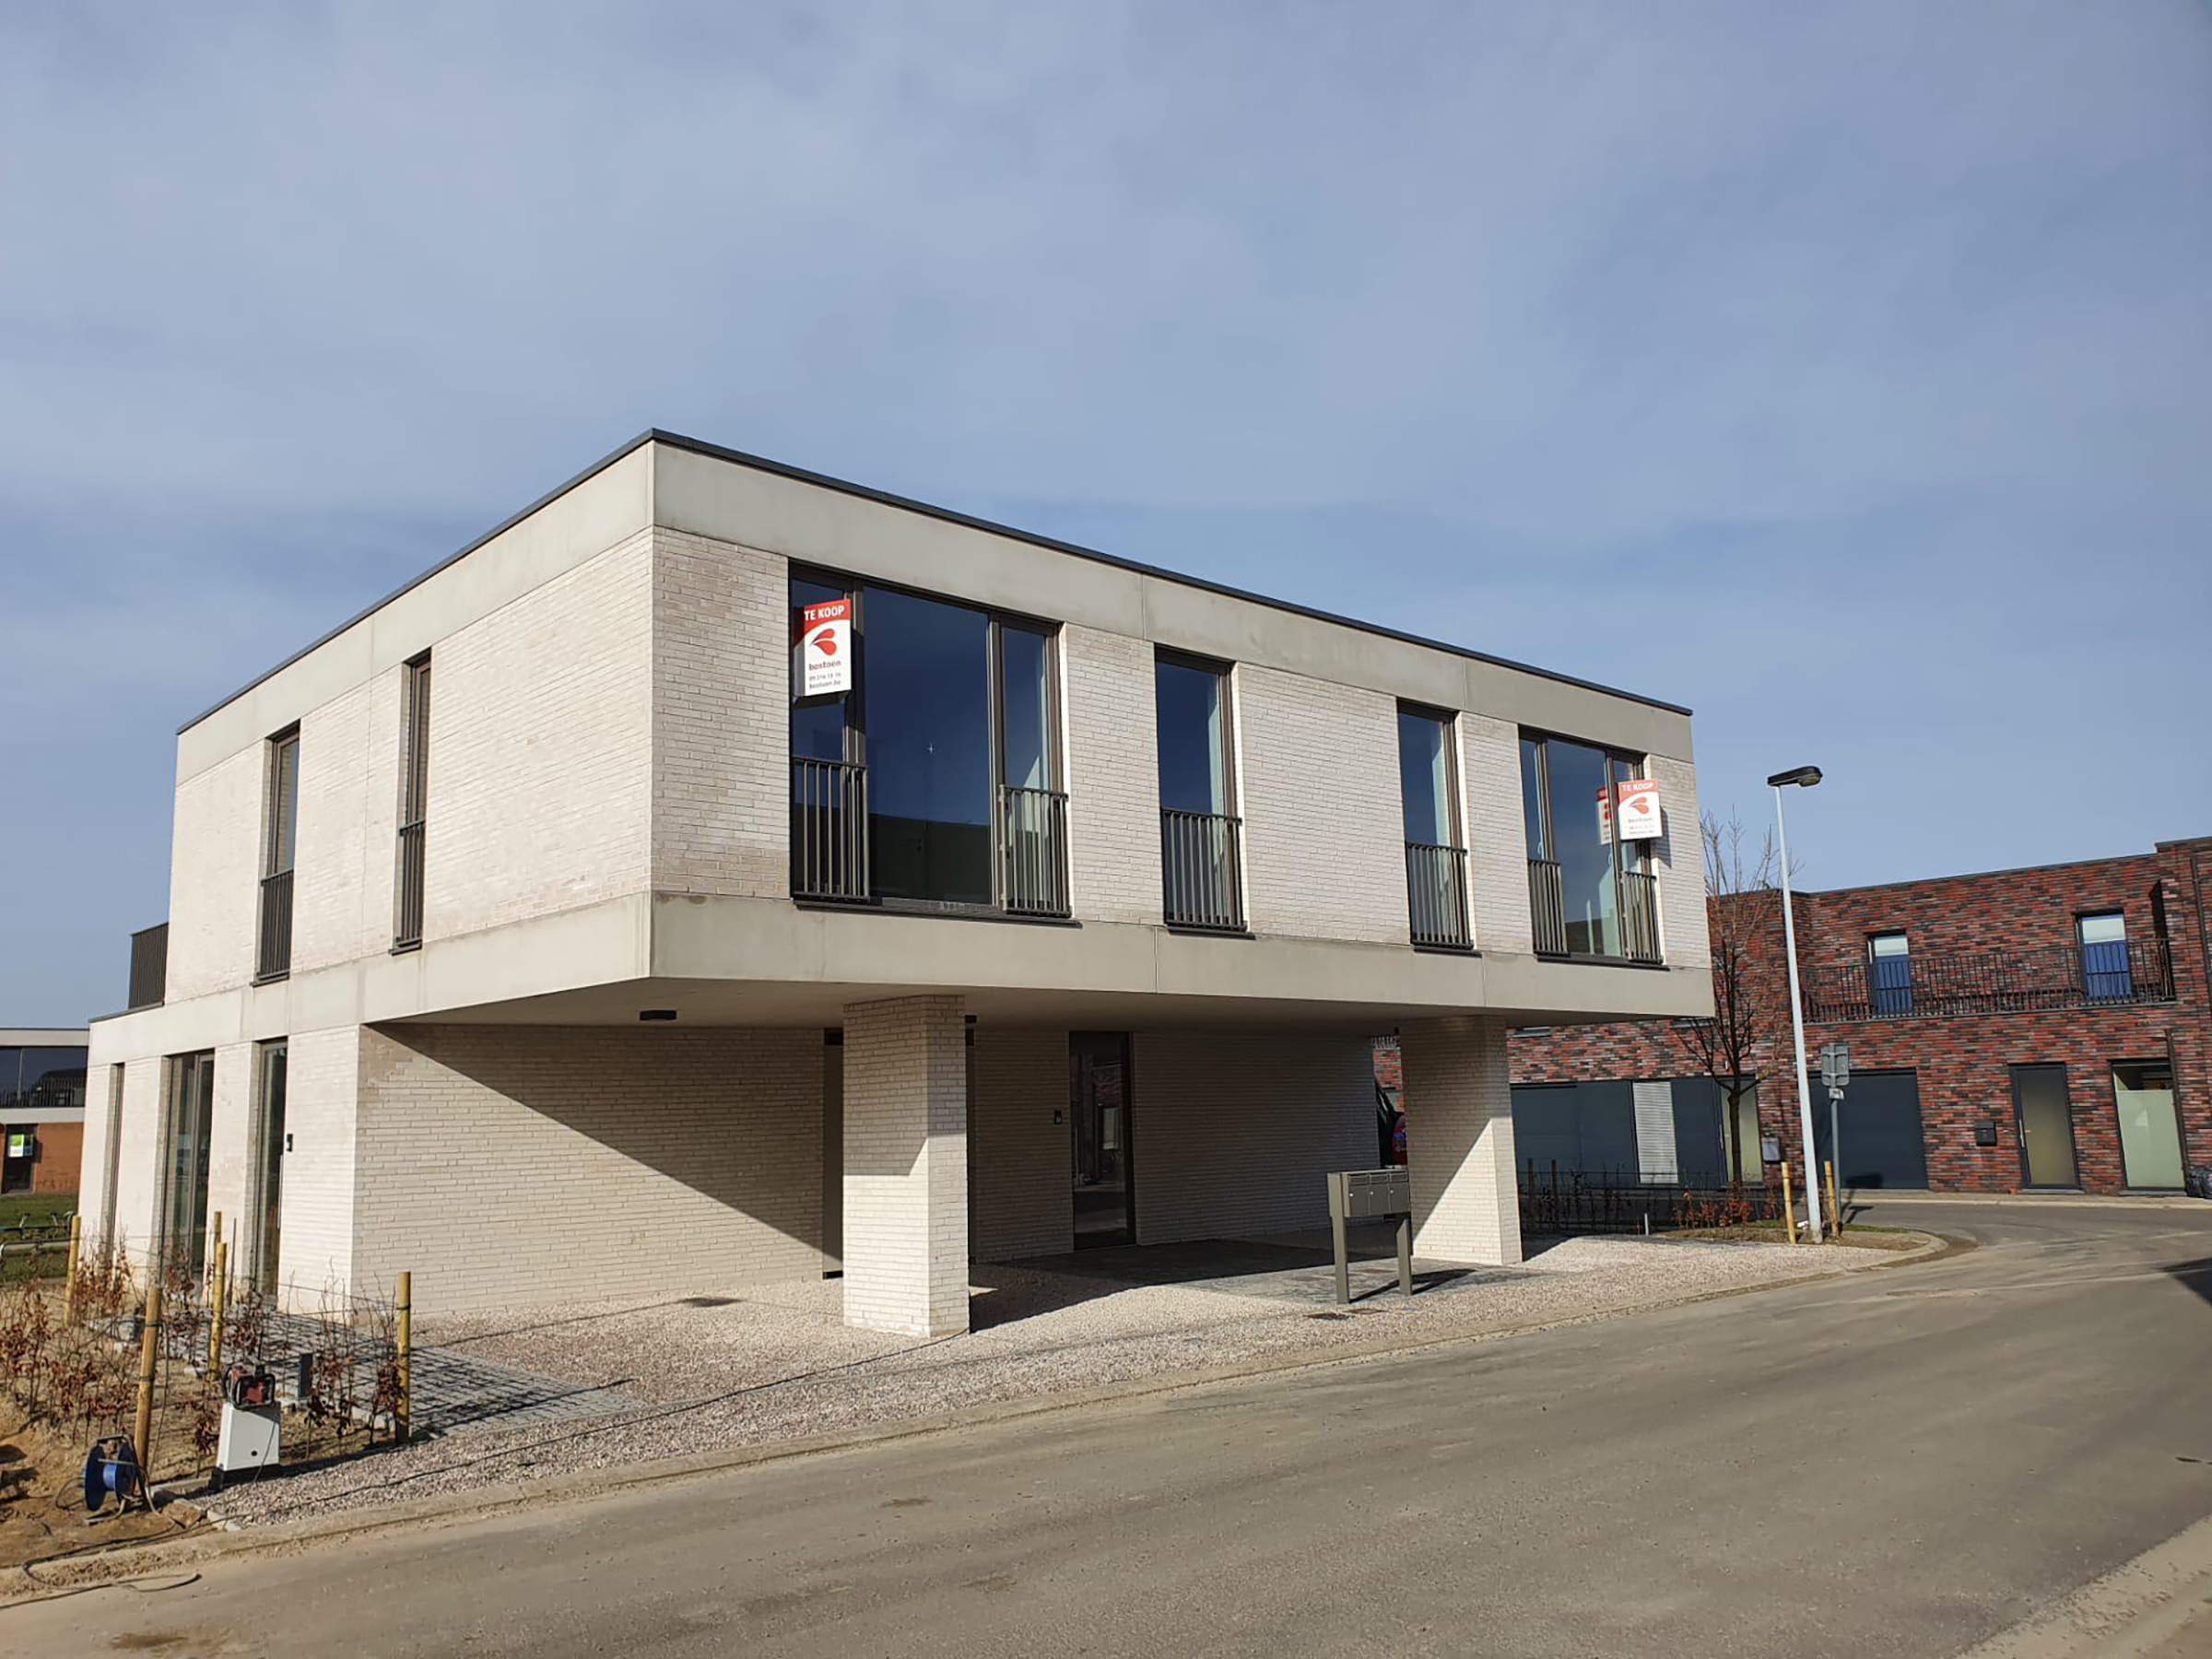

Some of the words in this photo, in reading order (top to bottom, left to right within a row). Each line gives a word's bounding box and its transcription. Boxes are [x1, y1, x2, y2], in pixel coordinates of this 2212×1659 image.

[804, 610, 816, 620] TE
[818, 606, 845, 618] KOOP
[808, 660, 841, 671] bostoen
